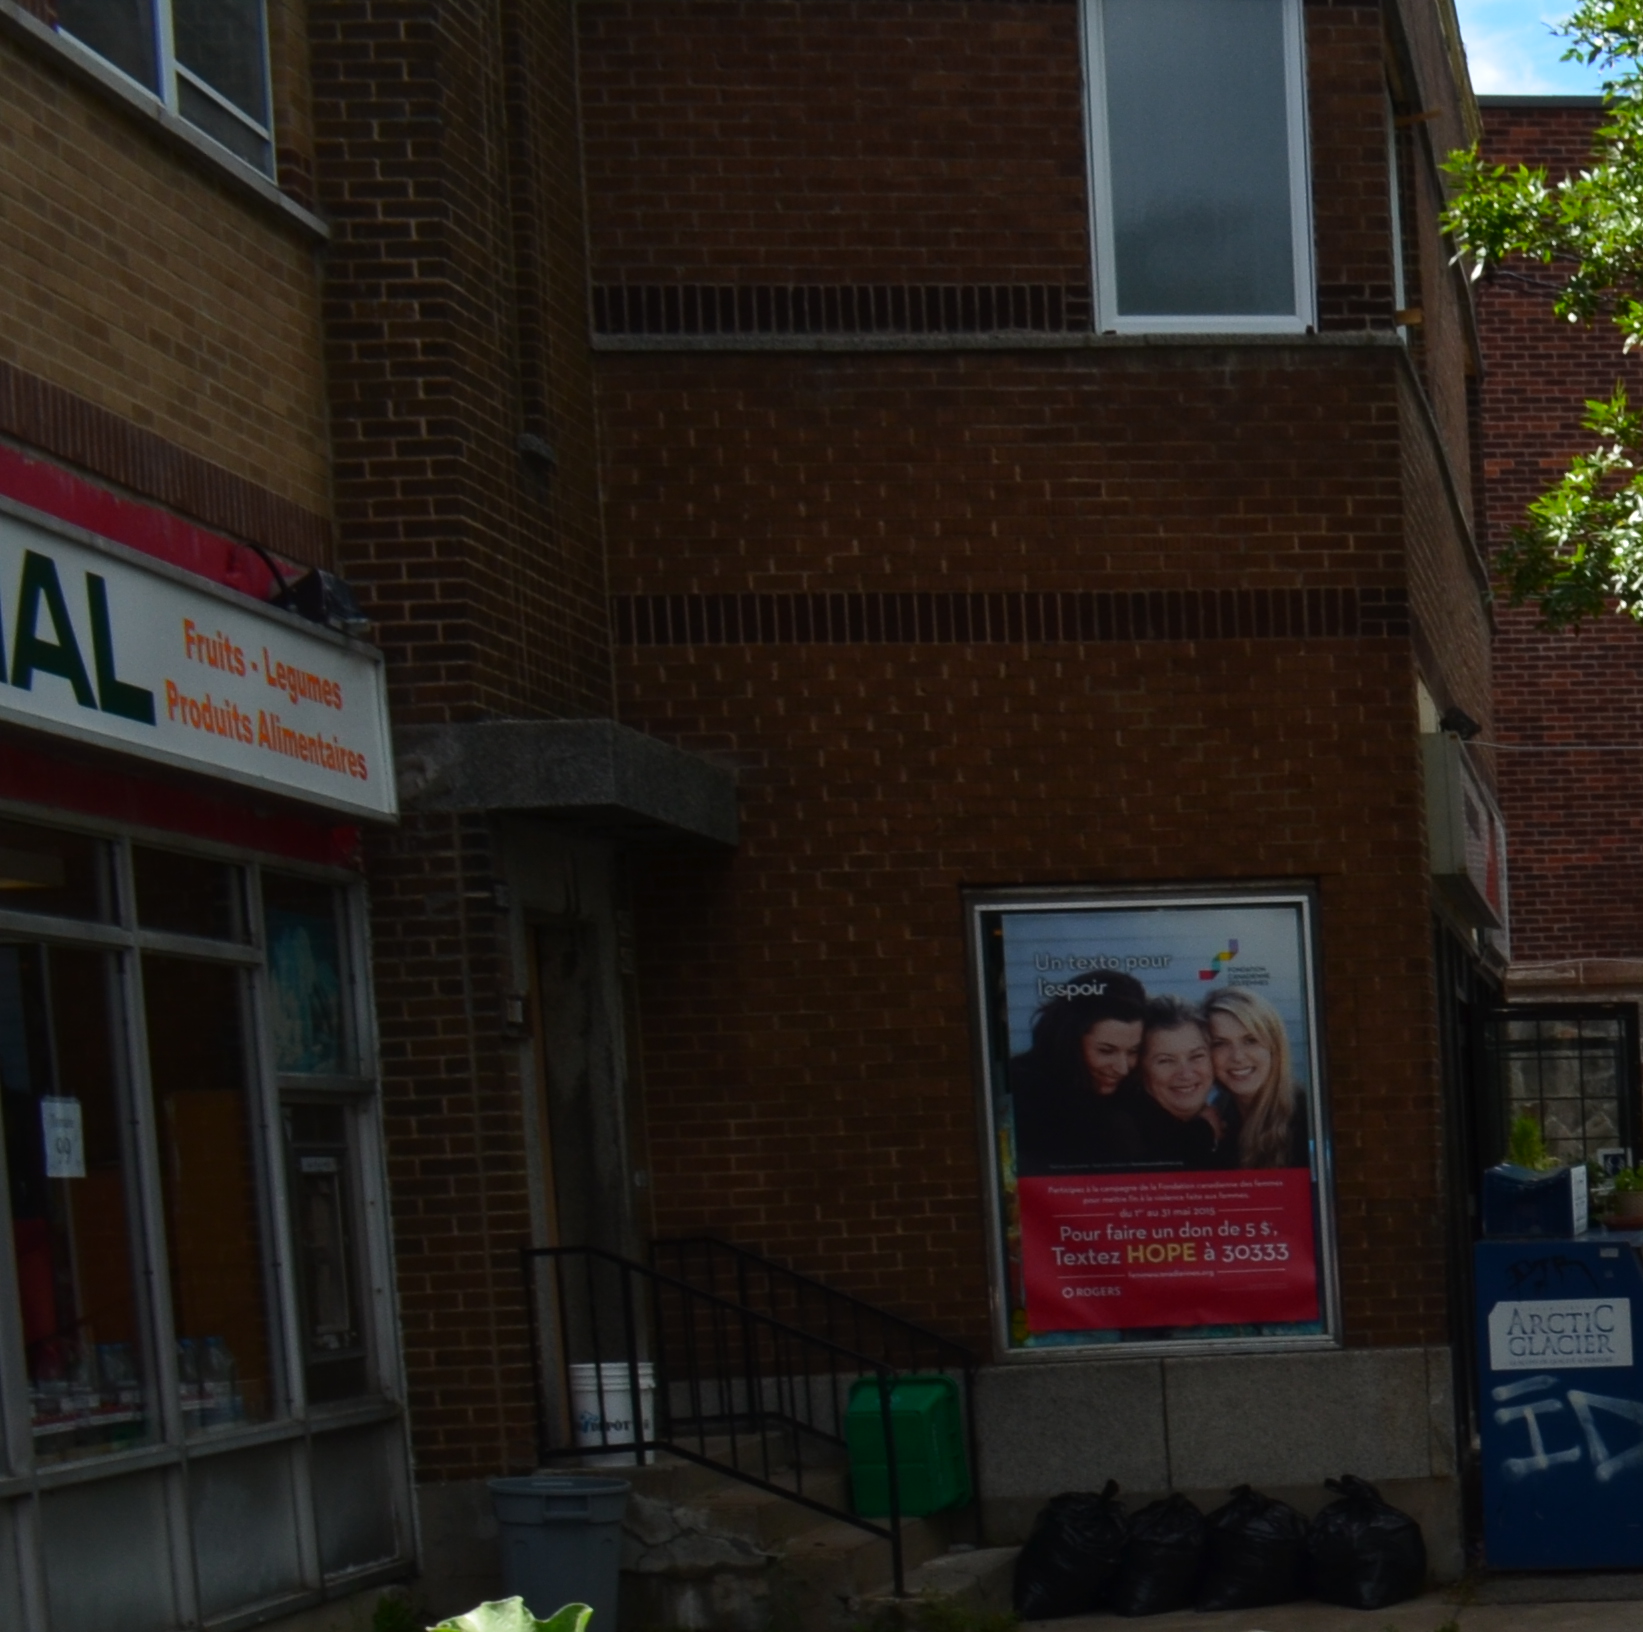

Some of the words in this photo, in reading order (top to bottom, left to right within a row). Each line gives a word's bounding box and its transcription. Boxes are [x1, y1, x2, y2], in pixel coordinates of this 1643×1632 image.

[0, 548, 156, 727] AL
[183, 617, 246, 678] Fruits
[263, 646, 343, 711] Legumes
[164, 677, 254, 745] Produits
[257, 708, 369, 782] Alimentaires
[1034, 953, 1064, 971] Un
[1068, 954, 1119, 970] texto
[1124, 955, 1171, 975] pour
[1060, 1224, 1101, 1242] Pour
[1106, 1222, 1147, 1240] faire
[1152, 1225, 1174, 1239] un
[1178, 1221, 1214, 1238] don
[1217, 1219, 1241, 1237] de
[1245, 1223, 1256, 1237] 5
[1050, 1245, 1121, 1266] Textez
[1126, 1241, 1198, 1264] HOPE
[1203, 1241, 1215, 1261] à
[1221, 1243, 1290, 1263] 30333
[1076, 1286, 1122, 1297] ROGERS
[1506, 1304, 1615, 1336] ARCTIC
[1508, 1333, 1616, 1357] GLACIER
